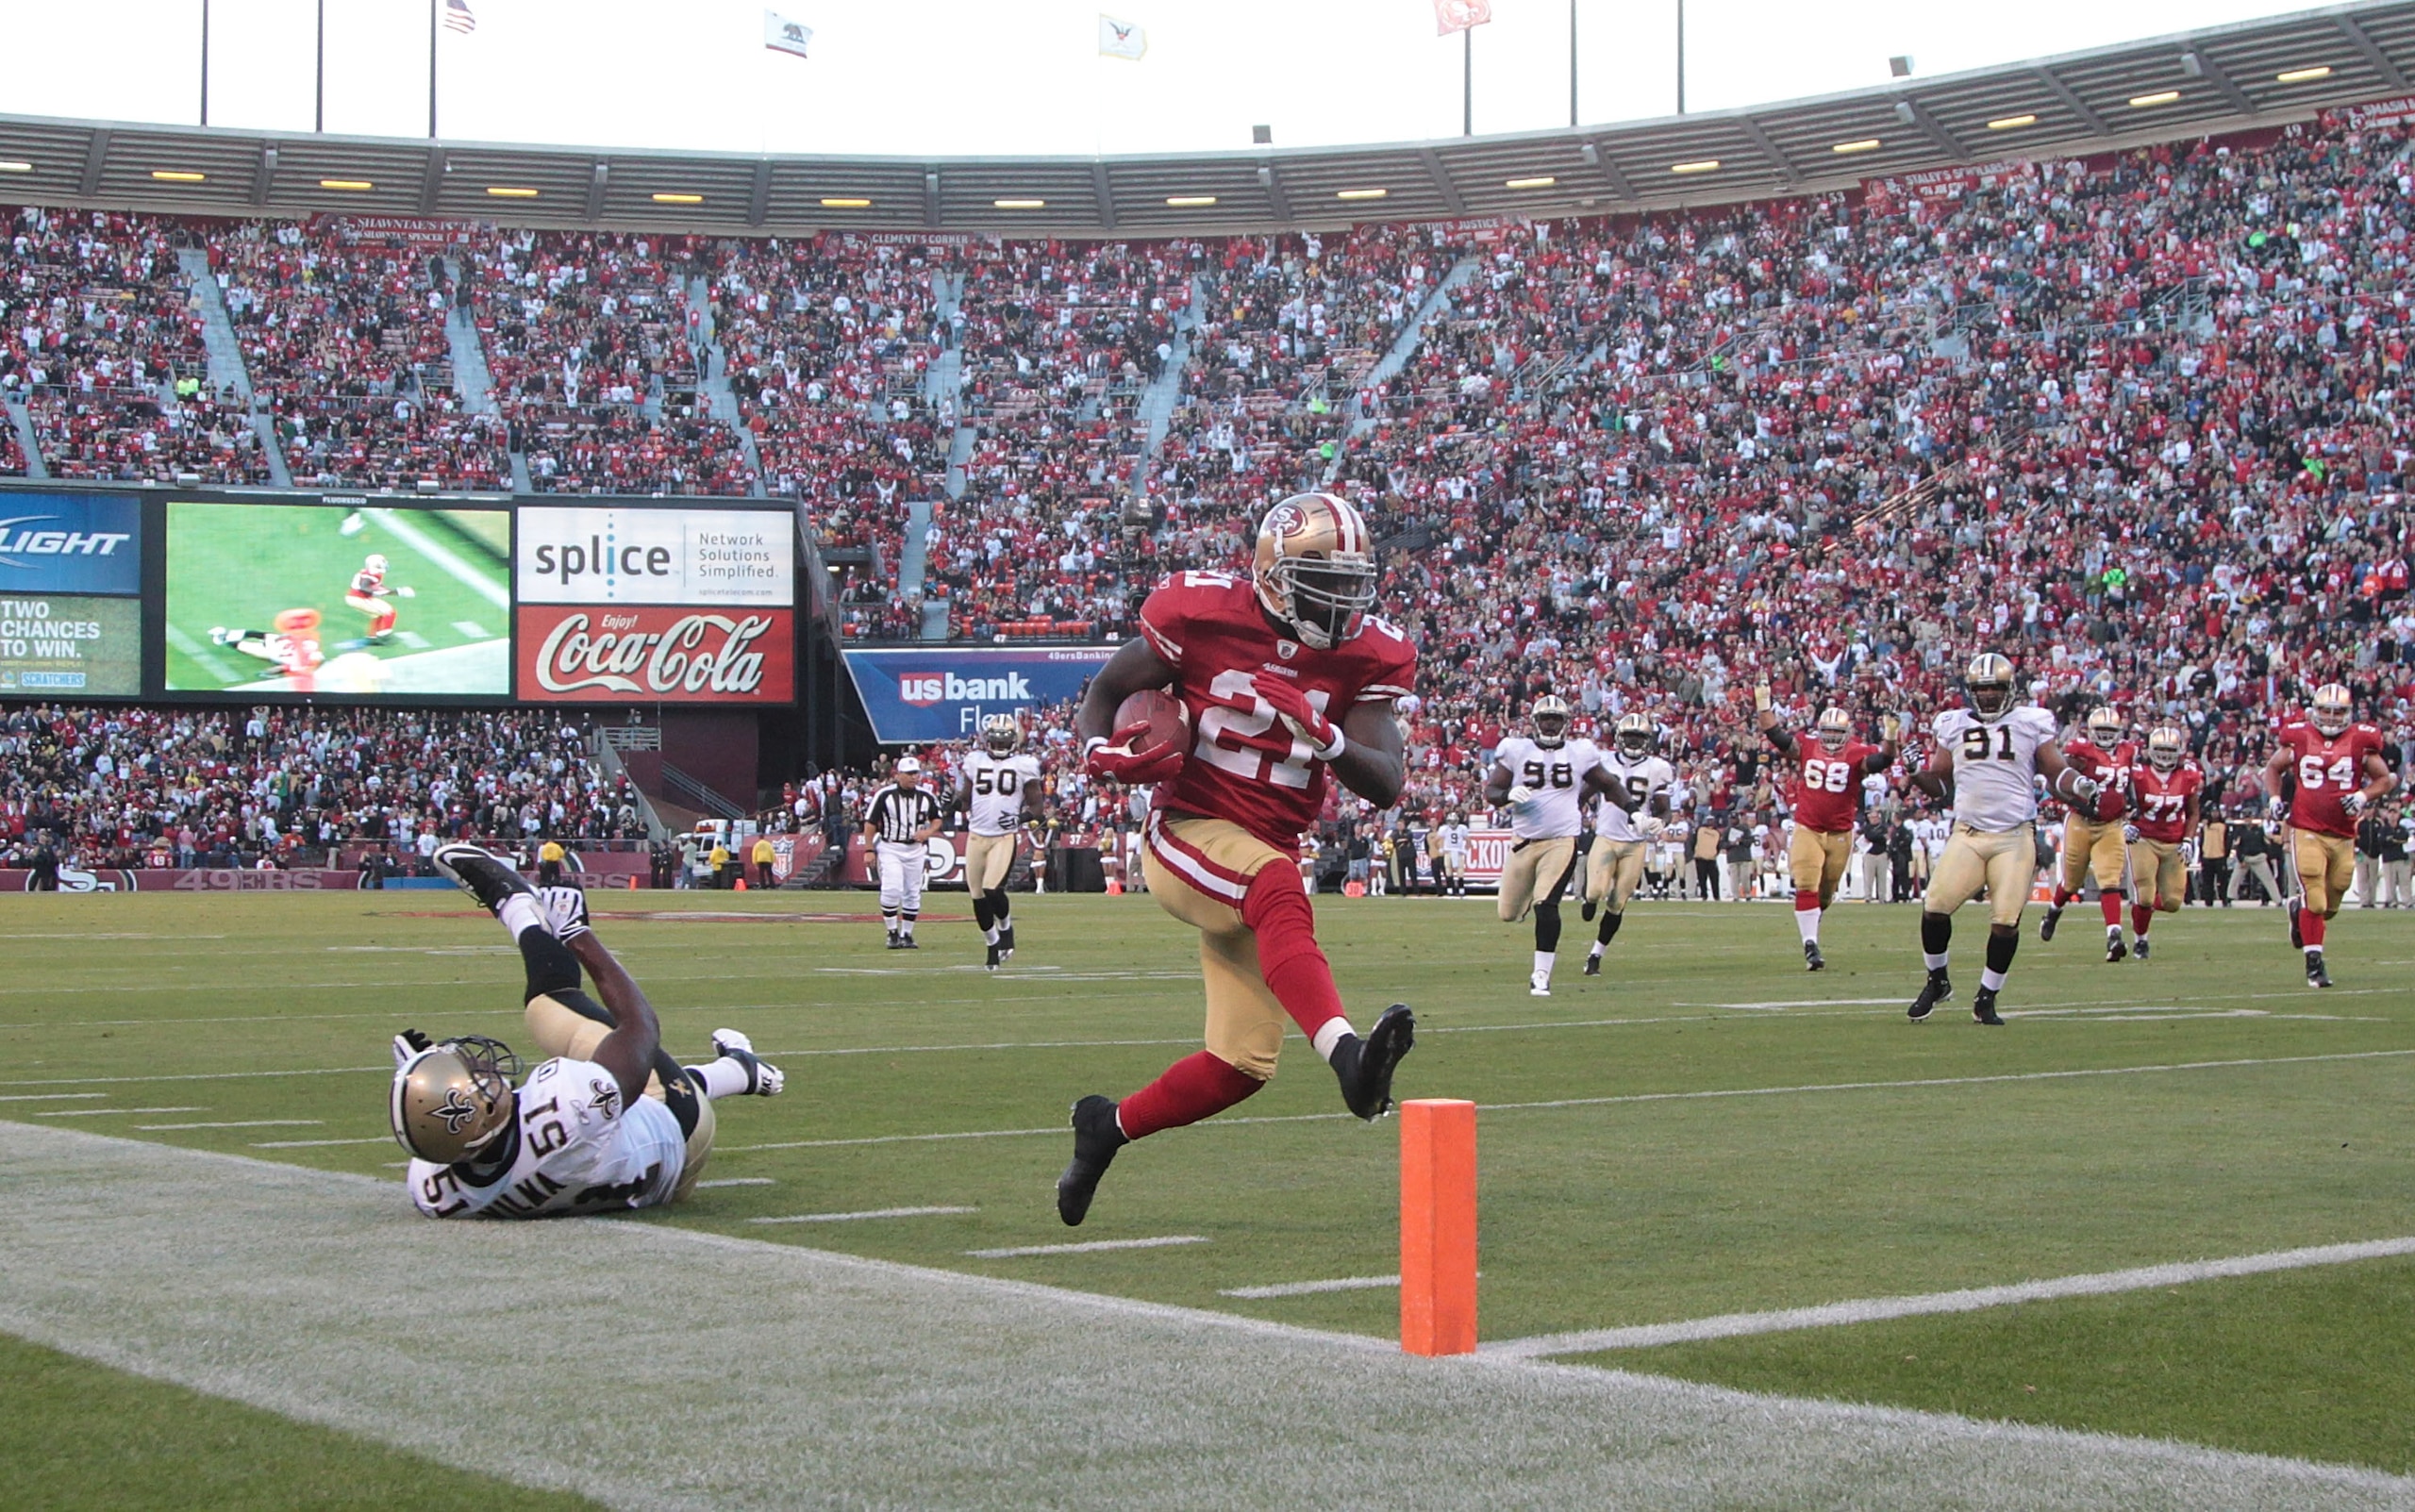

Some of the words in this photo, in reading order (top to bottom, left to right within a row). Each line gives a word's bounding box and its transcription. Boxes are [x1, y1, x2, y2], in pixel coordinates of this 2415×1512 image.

[1457, 218, 1499, 230] JUSTICE
[699, 533, 763, 545] Network
[536, 535, 671, 585] splice
[699, 549, 770, 561] Solutions
[699, 565, 779, 579] Simplified.
[0, 601, 50, 619] TWO
[1, 620, 101, 639] CHANCES
[601, 614, 639, 628] Enjoy!
[993, 634, 1007, 643] 47
[1105, 632, 1119, 641] 45
[0, 640, 27, 656] TO
[34, 640, 81, 657] WIN.
[536, 614, 772, 692] Coca-Cola
[1194, 668, 1330, 789] 21
[1963, 725, 2015, 760] 91
[1523, 760, 1573, 789] 98
[1804, 758, 1851, 792] 68
[2299, 755, 2354, 789] 64
[975, 768, 1017, 796] 50
[2144, 793, 2184, 822] 77
[1069, 834, 1082, 845] 37
[1450, 833, 1458, 844] 9
[174, 870, 322, 891] 49ERS
